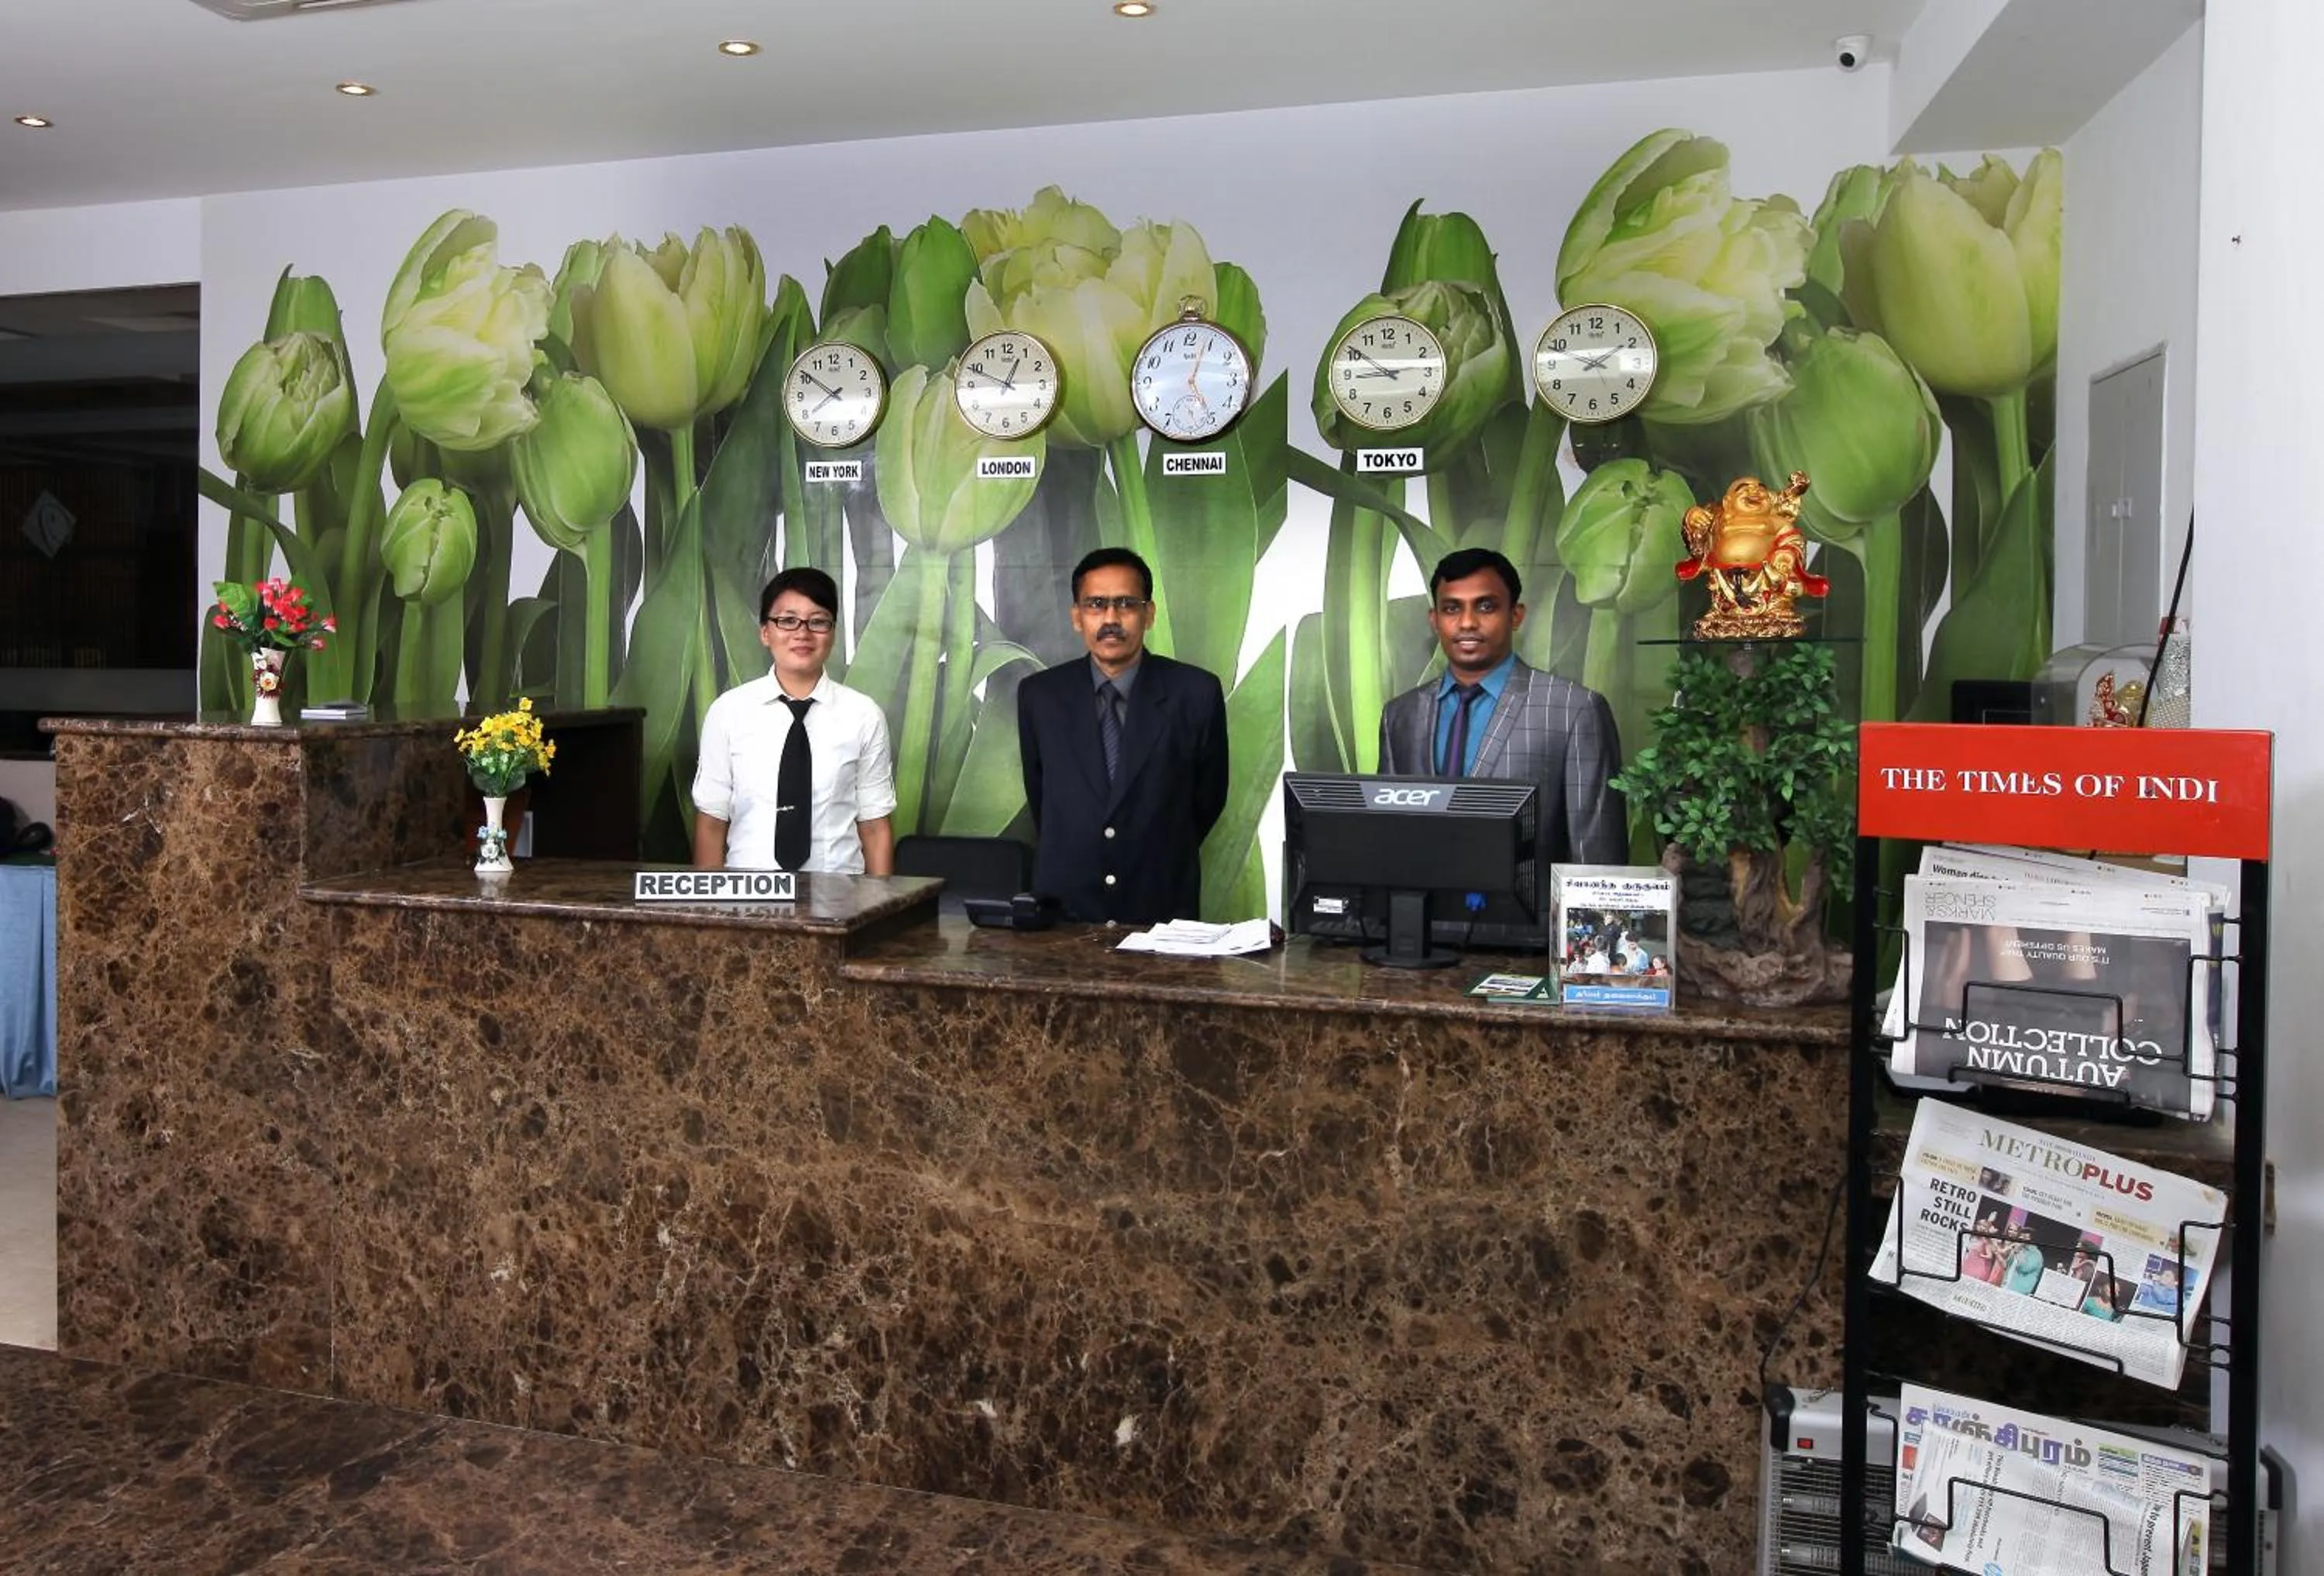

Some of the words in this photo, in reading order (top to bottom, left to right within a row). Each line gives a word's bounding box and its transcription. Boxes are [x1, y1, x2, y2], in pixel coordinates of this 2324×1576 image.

[1569, 323, 1581, 335] 11
[1589, 317, 1603, 329] 12
[1183, 332, 1197, 346] 12
[1381, 329, 1395, 339] 12
[1163, 339, 1174, 353] 11
[1362, 335, 1373, 346] 11
[1552, 339, 1567, 351] 10
[985, 349, 994, 359] 11
[1001, 343, 1013, 353] 12
[828, 353, 839, 364] 12
[1147, 356, 1160, 369] 10
[813, 360, 822, 370] 11
[800, 374, 811, 384] 10
[1167, 456, 1222, 472] CHENNAI
[1363, 453, 1417, 467] TOKYO
[809, 466, 829, 477] NEW
[833, 466, 858, 477] YORK
[982, 462, 1031, 474] LONDON
[1881, 767, 1947, 791] THE
[1956, 770, 2062, 796] TIMES
[2074, 775, 2126, 798] OF
[1373, 788, 1440, 807] acer
[639, 876, 791, 894] RECEPTION
[1925, 893, 1996, 907] SPENCER
[2072, 945, 2106, 954] MAKES
[2027, 951, 2066, 962] QUALITY
[1943, 1017, 2161, 1065] COLLECTION
[1967, 1045, 2126, 1087] AUTUMN
[1930, 1178, 1977, 1203] RETRO
[1934, 1196, 1972, 1220] STILL
[1920, 1208, 1968, 1231] ROCKS
